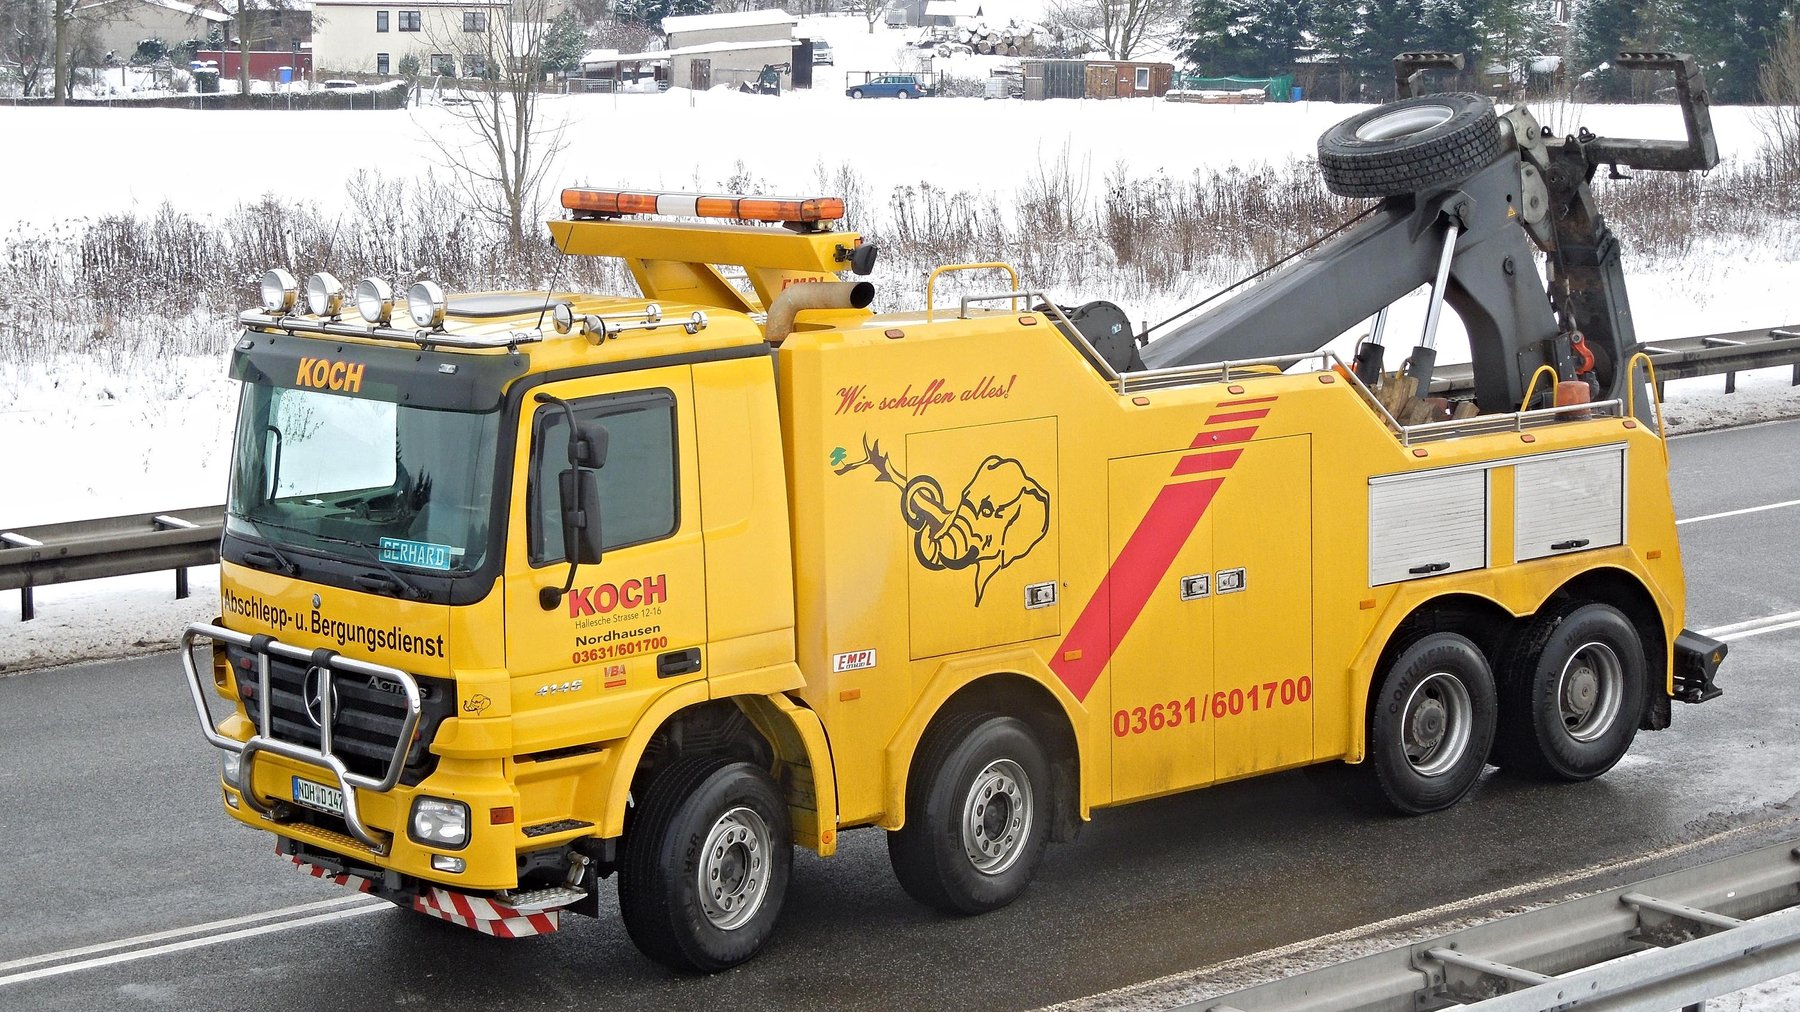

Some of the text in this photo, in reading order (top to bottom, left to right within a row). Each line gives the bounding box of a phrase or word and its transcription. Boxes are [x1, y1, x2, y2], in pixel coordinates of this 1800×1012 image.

[296, 357, 365, 393] KOCH
[835, 374, 1017, 416] Wir schaffen alles!
[383, 540, 445, 566] GERHARD
[568, 574, 668, 619] KOCH
[223, 588, 444, 658] Abschlepp- u. Bergungsdienst
[575, 607, 662, 630] Hallesche Strasse 12-16
[575, 624, 661, 647] Nordhausen
[572, 636, 668, 664] 03631/601700
[838, 651, 871, 670] EMPL
[1113, 675, 1312, 738] 03631/601700
[299, 781, 315, 802] NDH
